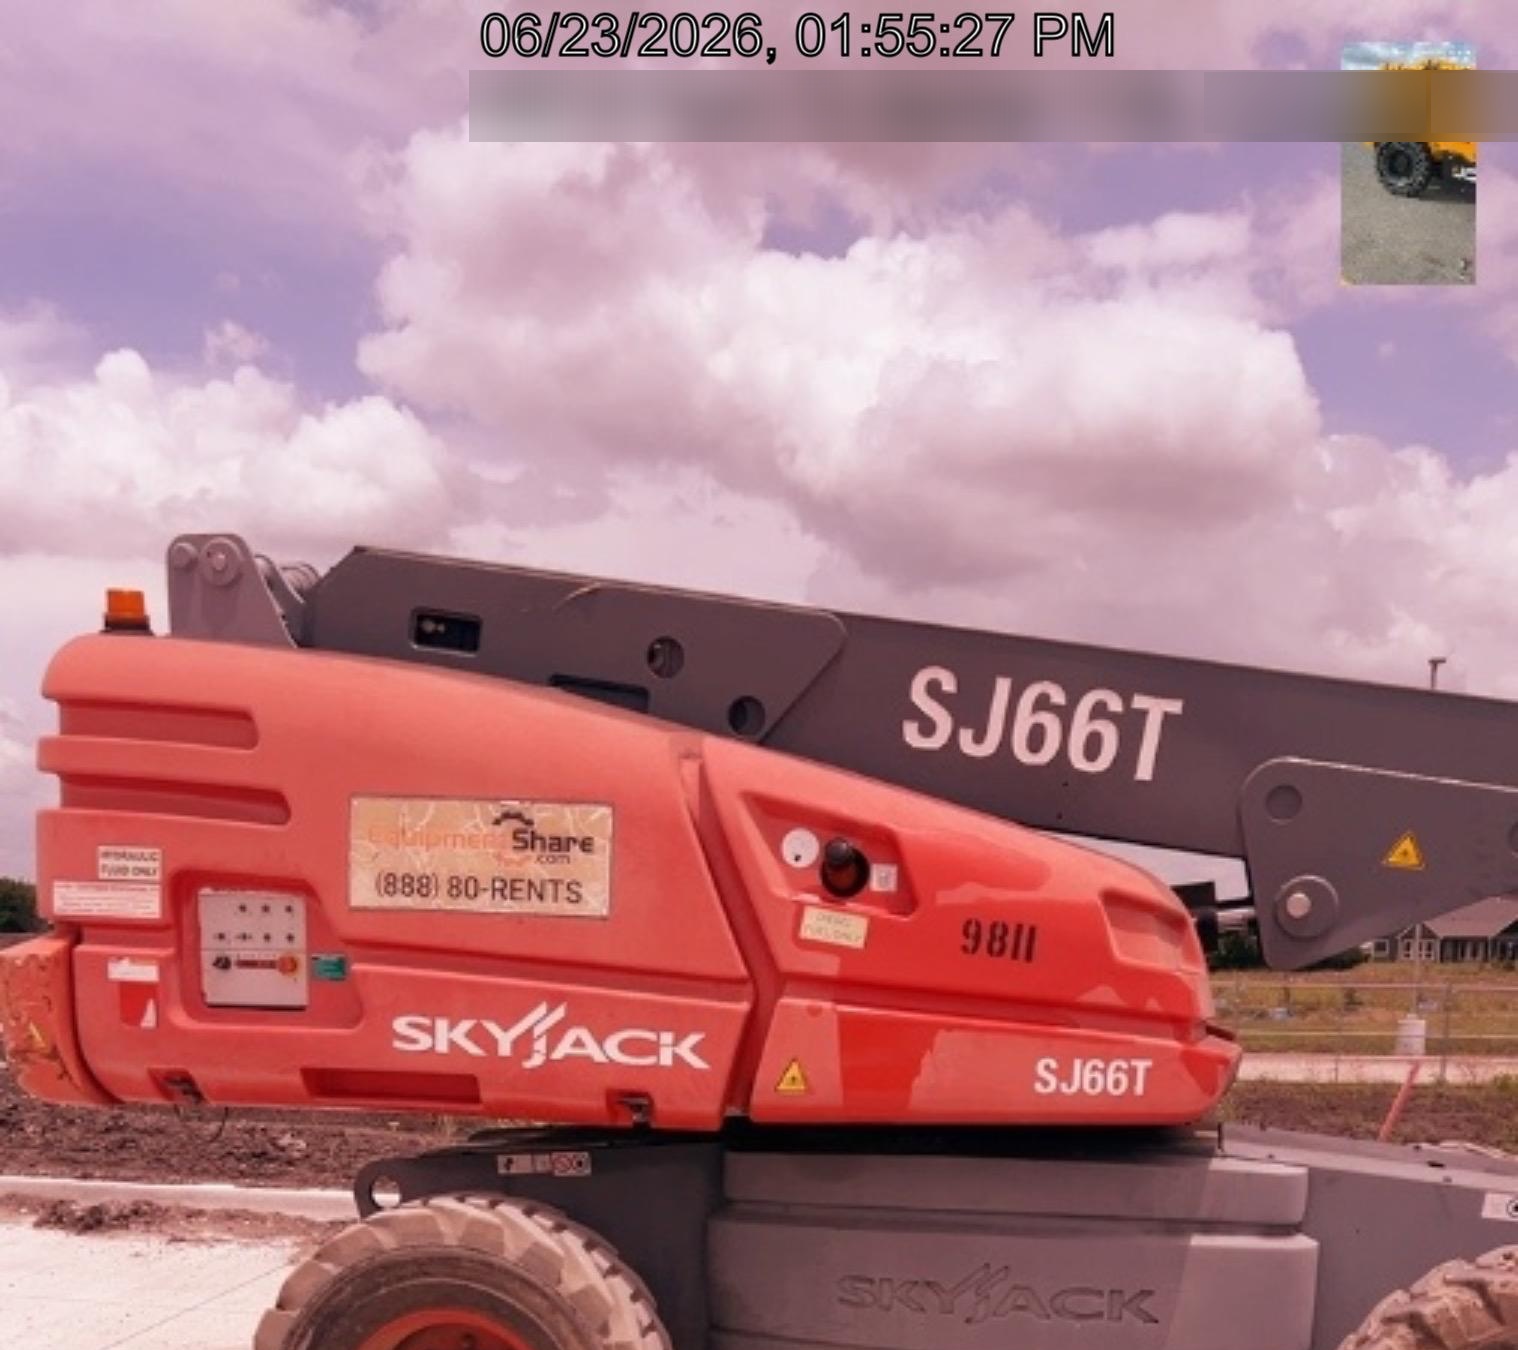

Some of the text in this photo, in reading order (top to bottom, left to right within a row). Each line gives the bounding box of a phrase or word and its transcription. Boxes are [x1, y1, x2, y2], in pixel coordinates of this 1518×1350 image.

[902, 665, 1183, 782] SJ66T
[376, 872, 584, 905] (888) 80-RENTS
[961, 917, 1036, 963] 9811
[392, 1001, 710, 1069] SKYJACK
[1034, 1056, 1152, 1096] SJ66T
[836, 1262, 1159, 1324] SKYJACK
